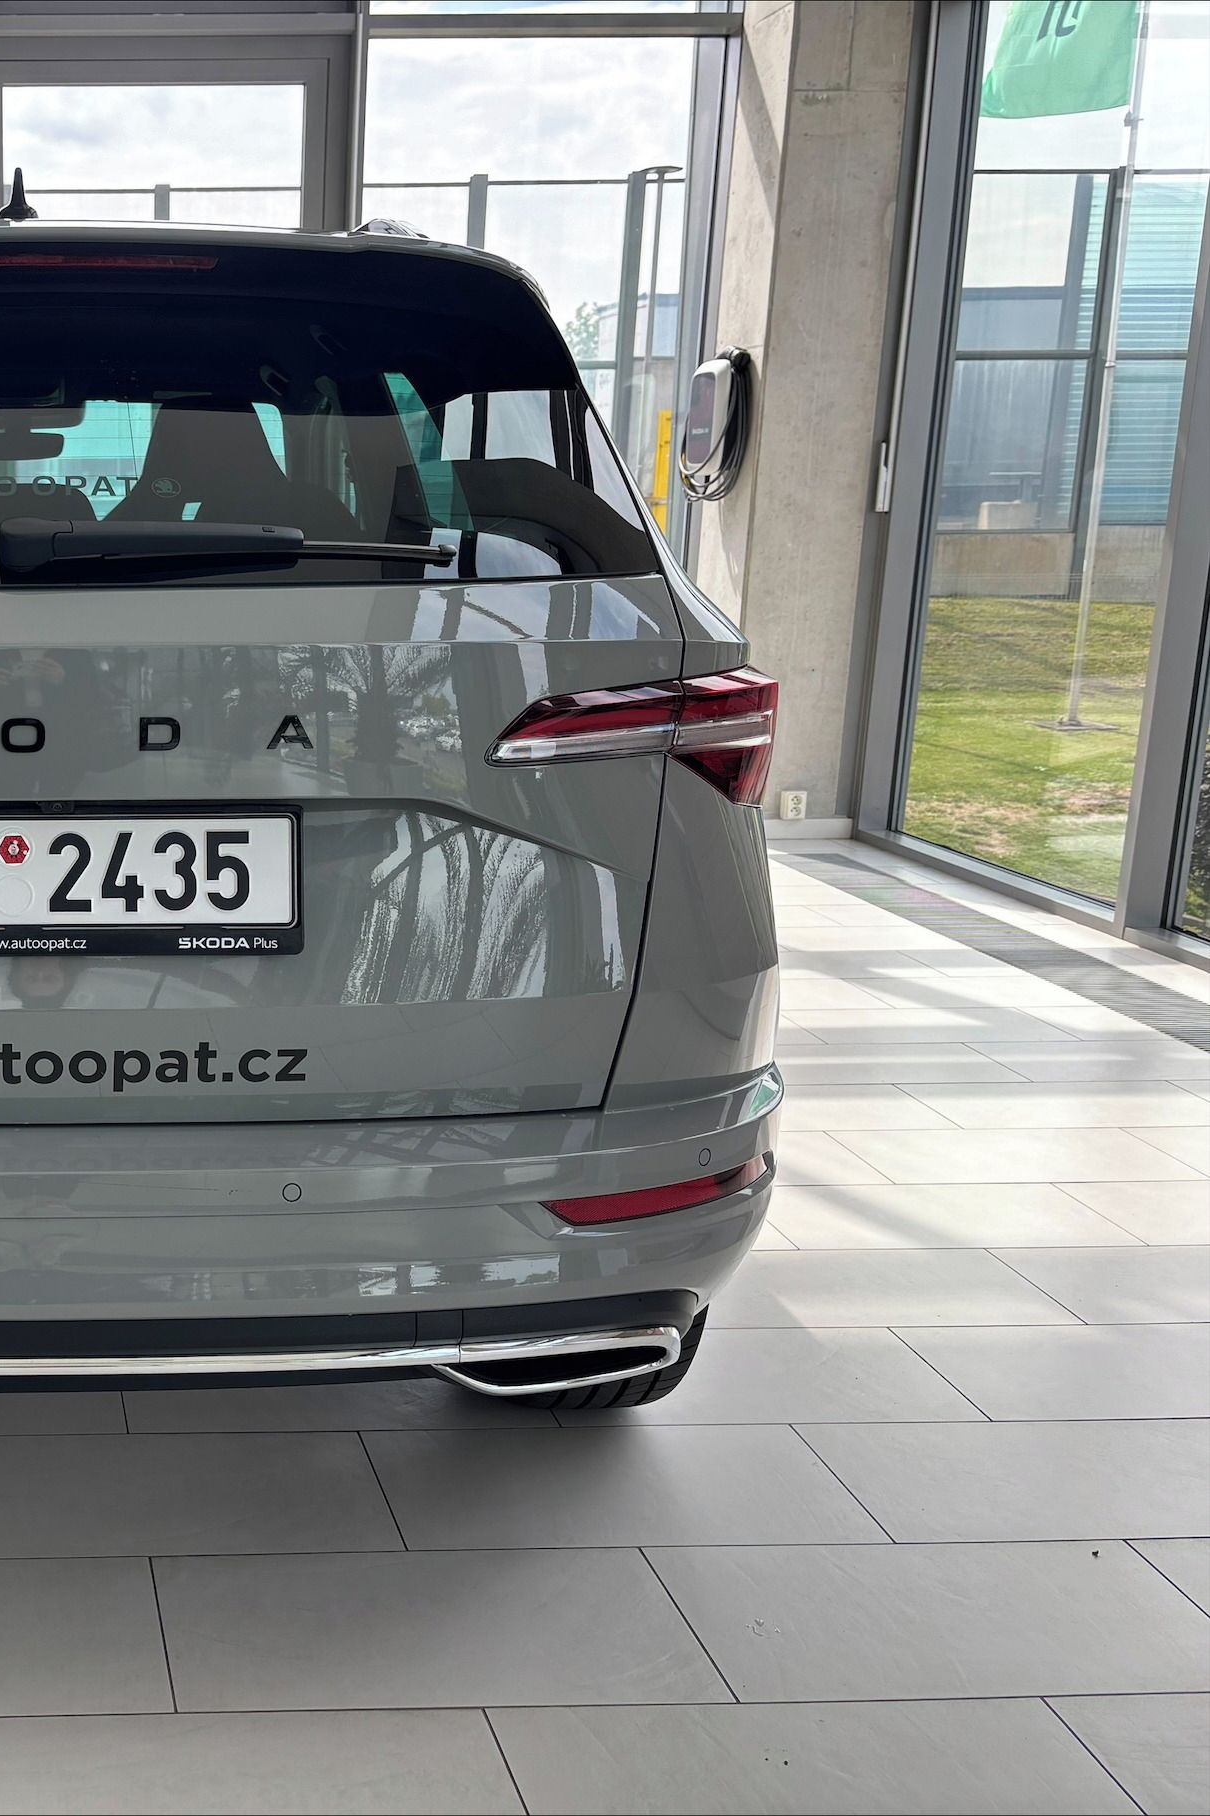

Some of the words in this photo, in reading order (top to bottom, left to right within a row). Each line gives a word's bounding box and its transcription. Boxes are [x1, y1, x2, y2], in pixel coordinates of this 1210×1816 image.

[32, 475, 138, 497] OPAT
[48, 831, 252, 912] 2435
[253, 937, 278, 949] Plus
